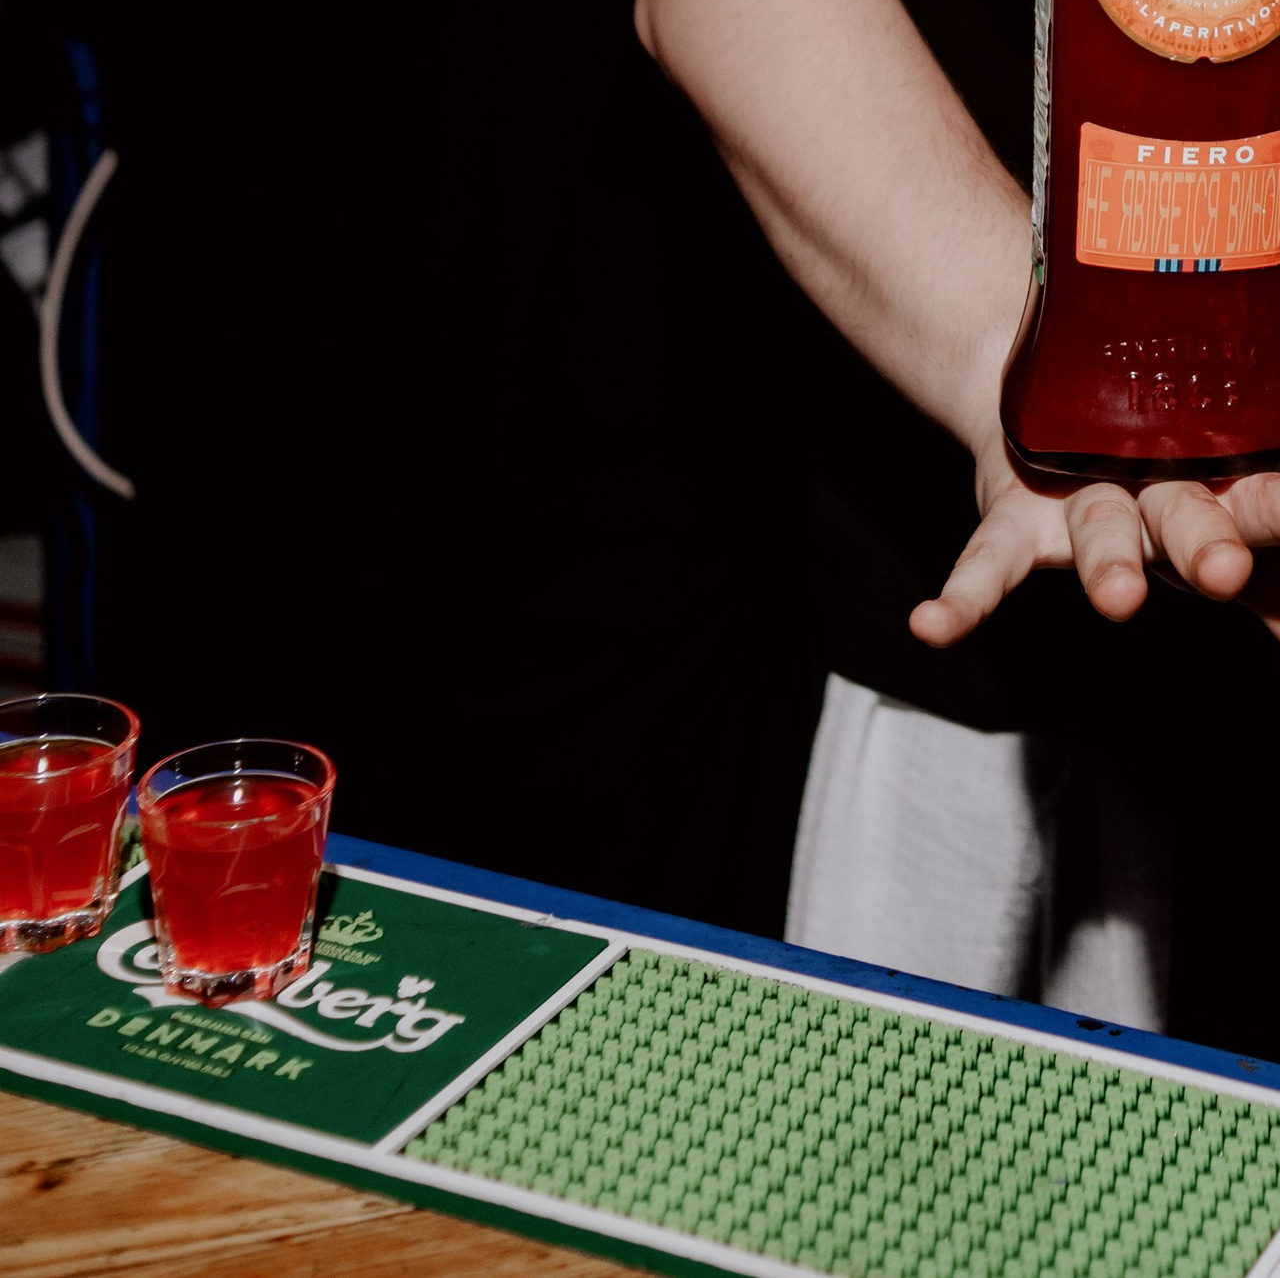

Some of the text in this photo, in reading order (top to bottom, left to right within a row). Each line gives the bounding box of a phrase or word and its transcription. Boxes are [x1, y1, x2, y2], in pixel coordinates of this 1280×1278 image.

[1139, 3, 1271, 39] L'APERITIVO
[1137, 145, 1255, 165] FIERO
[1083, 165, 1112, 249] НЕ
[1117, 169, 1221, 255] ЯВЛЯЕТСЯ
